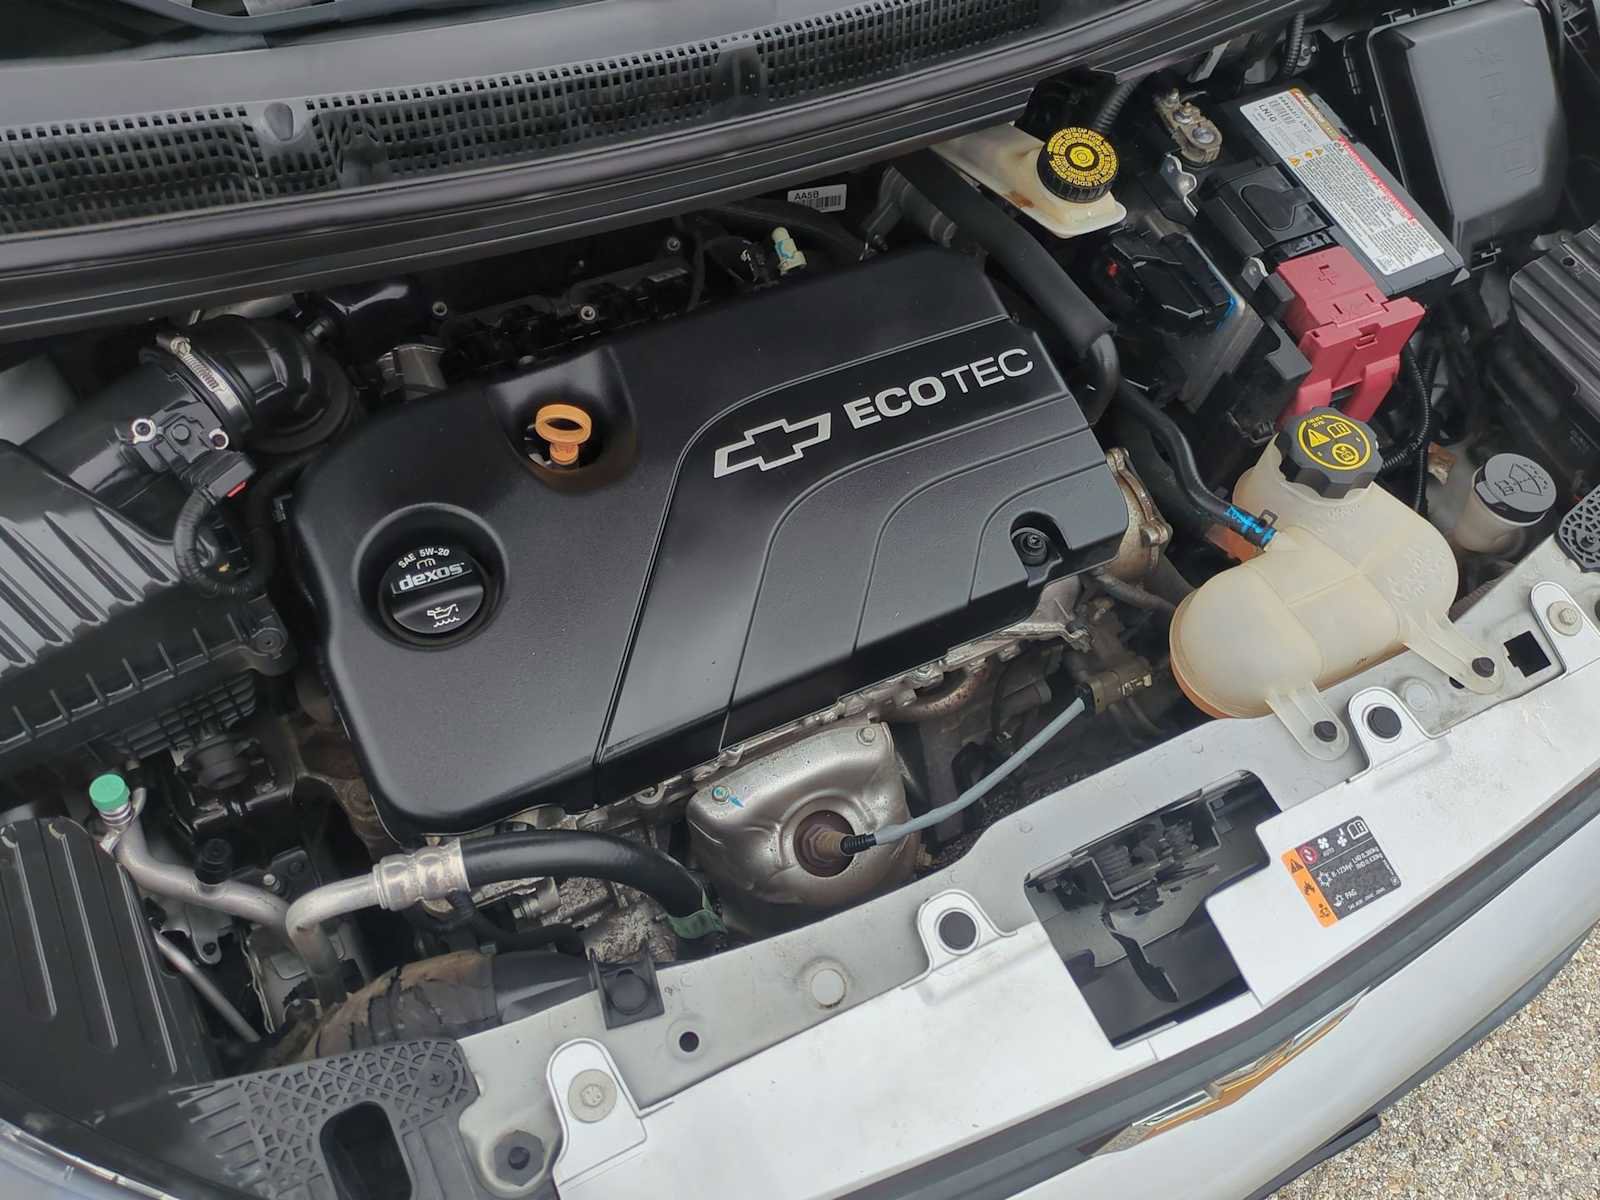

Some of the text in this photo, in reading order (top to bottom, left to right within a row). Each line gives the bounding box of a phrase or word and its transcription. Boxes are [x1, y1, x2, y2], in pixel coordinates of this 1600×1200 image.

[843, 348, 1033, 430] ECOTEC
[398, 547, 450, 568] SAE 5W-20
[399, 563, 463, 591] dexos
